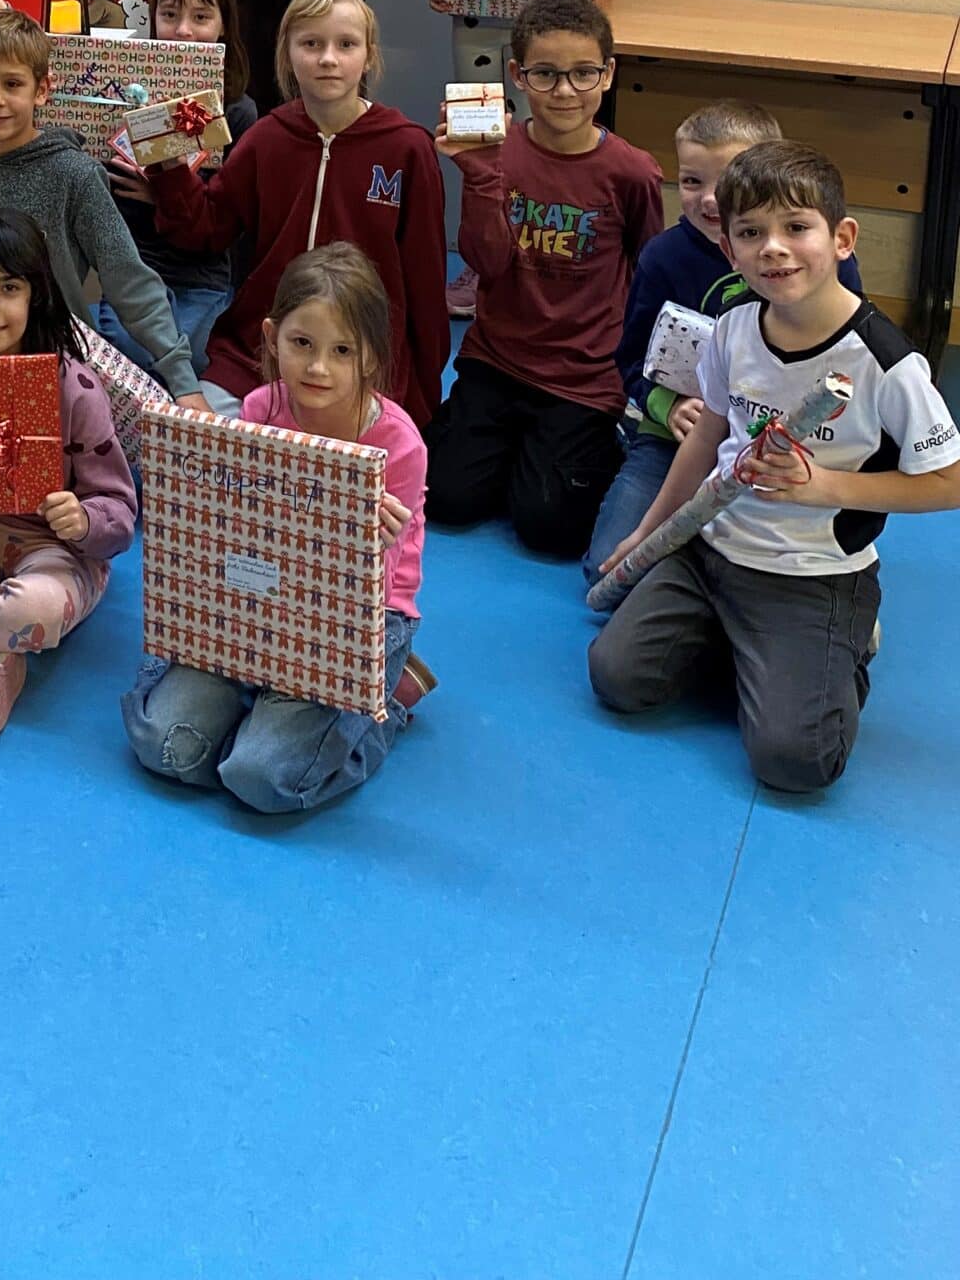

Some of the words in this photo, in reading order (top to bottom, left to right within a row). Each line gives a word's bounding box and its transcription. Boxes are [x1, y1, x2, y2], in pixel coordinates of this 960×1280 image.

[367, 165, 402, 204] M
[510, 195, 598, 237] SKATE
[519, 224, 588, 261] LIFE!
[183, 450, 268, 498] Gruppe
[281, 471, 319, 513] 47
